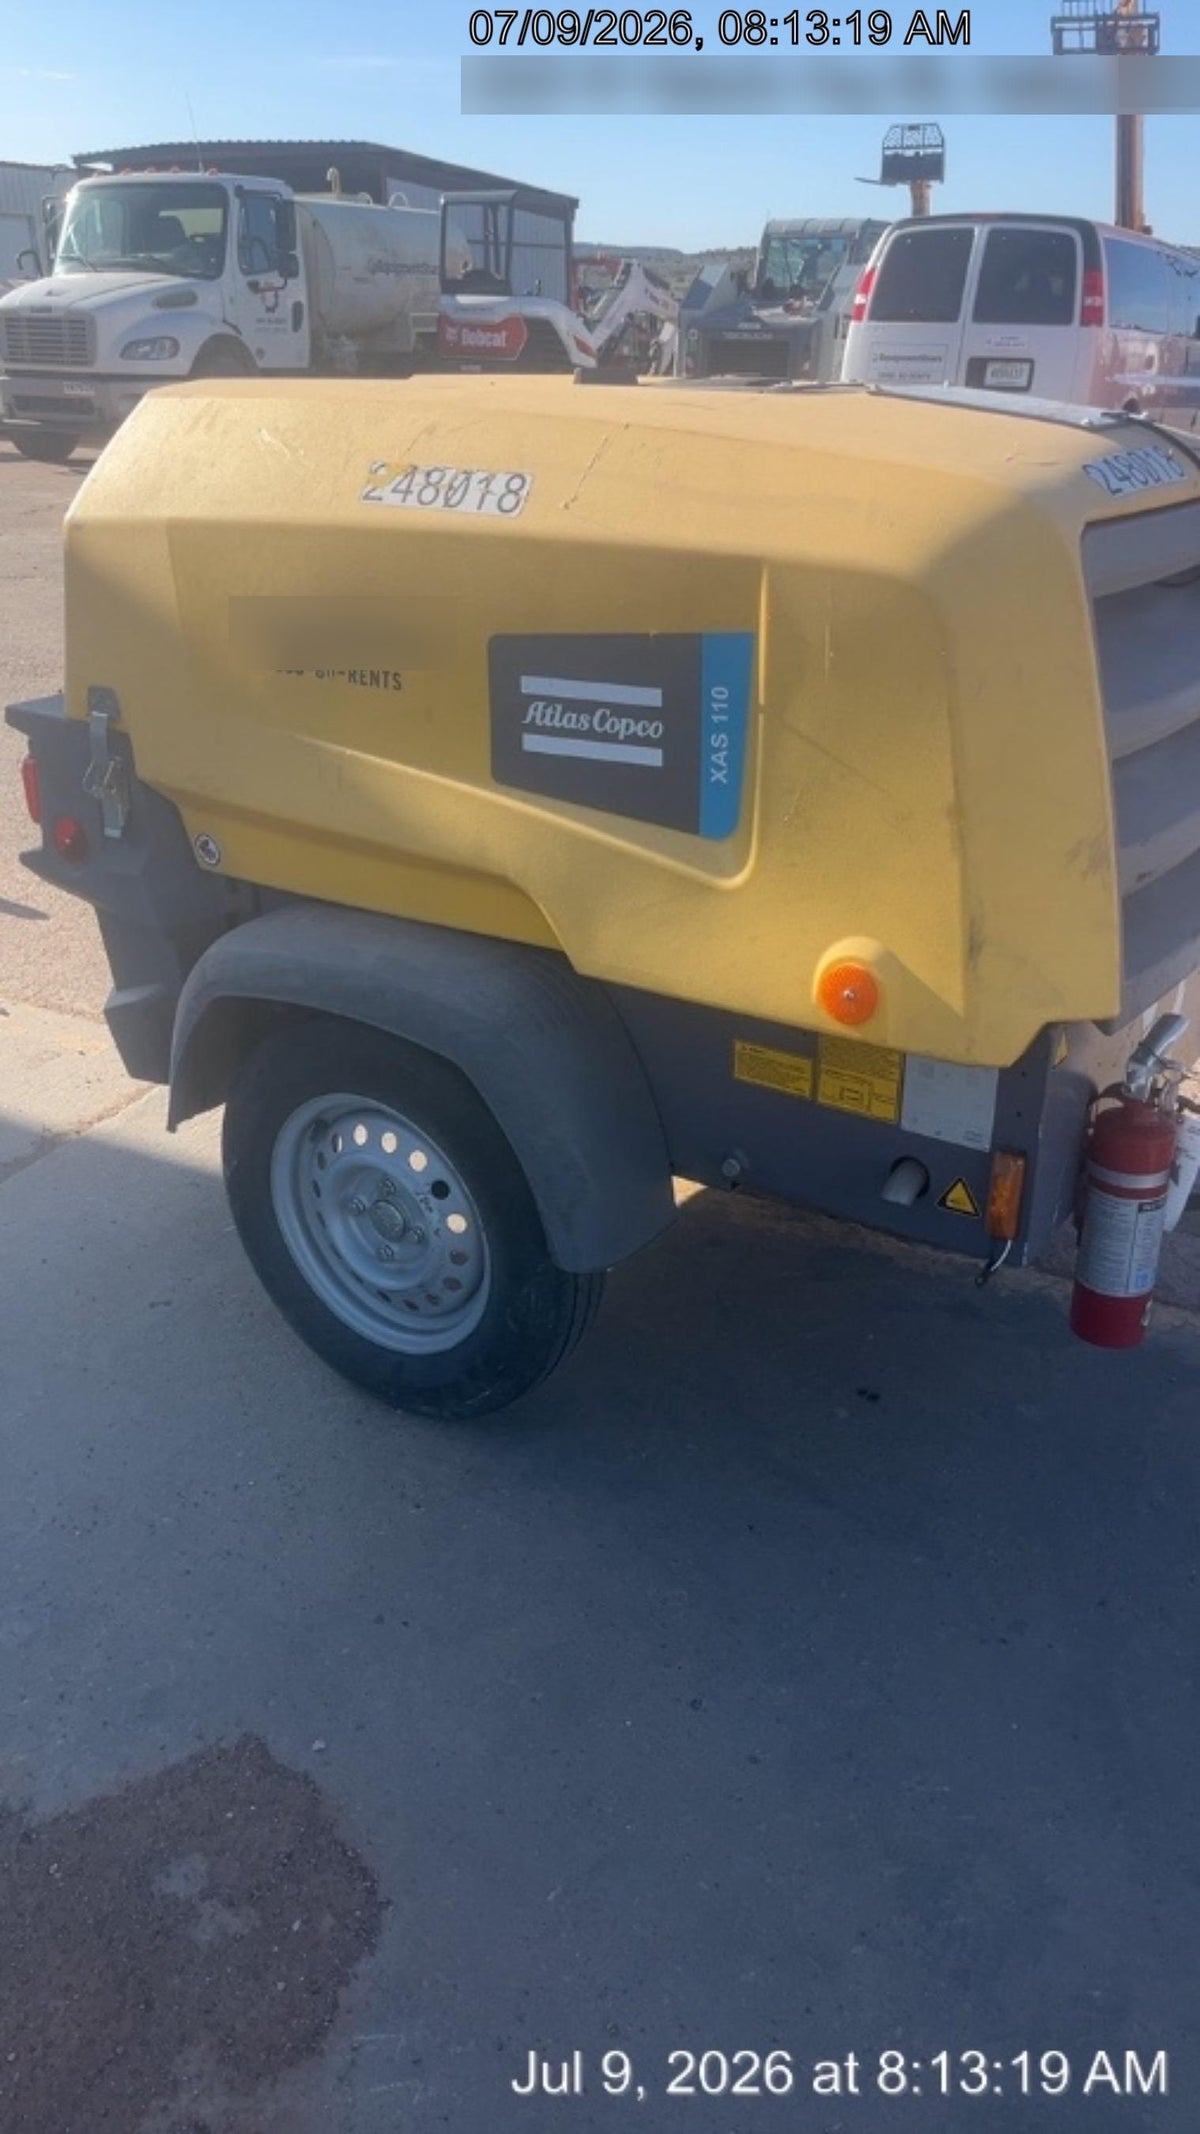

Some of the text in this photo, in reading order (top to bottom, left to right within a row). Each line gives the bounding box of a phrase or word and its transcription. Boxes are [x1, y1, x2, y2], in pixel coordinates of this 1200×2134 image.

[461, 326, 508, 347] Bobcat
[522, 702, 663, 740] Atlas Copco
[711, 686, 729, 784] XAS 110
